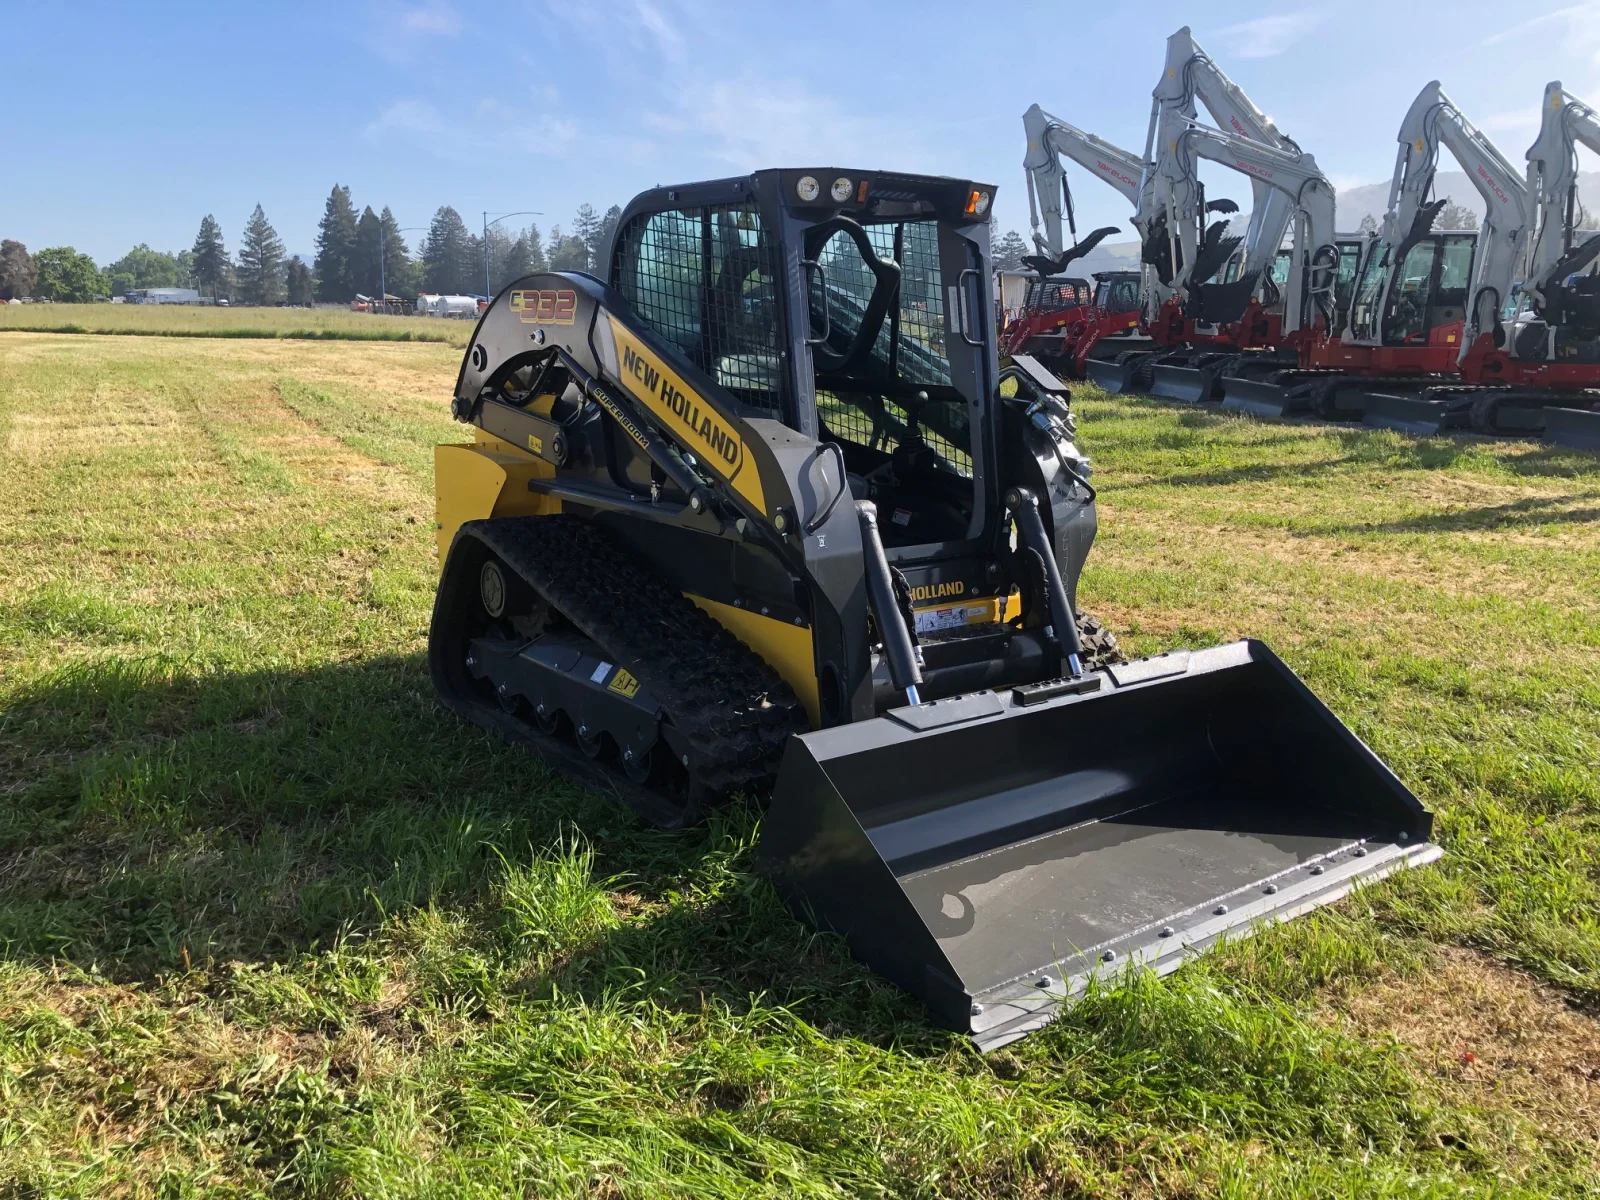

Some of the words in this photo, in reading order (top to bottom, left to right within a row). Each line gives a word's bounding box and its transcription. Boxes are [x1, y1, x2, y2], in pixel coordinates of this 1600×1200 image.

[623, 345, 659, 392] NEW
[660, 379, 737, 465] HOLLAND
[911, 581, 965, 601] HOLLAND
